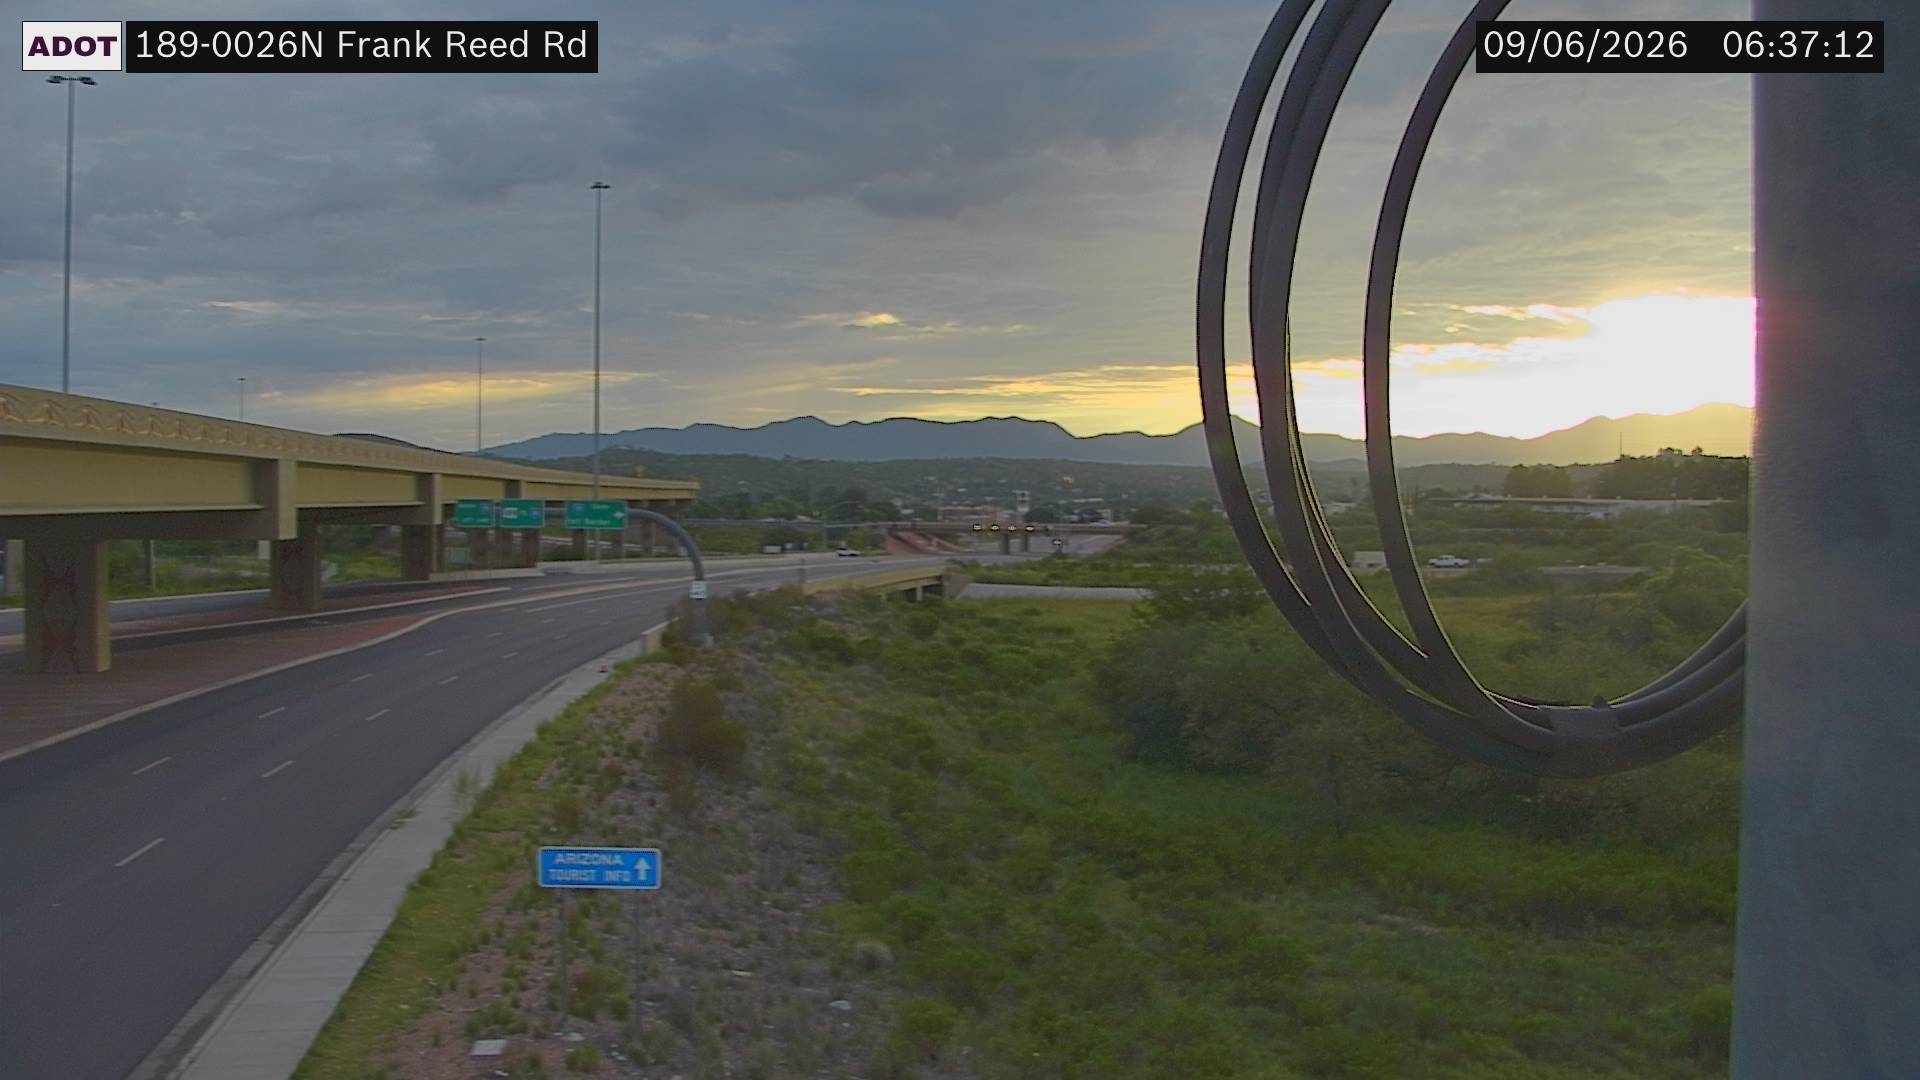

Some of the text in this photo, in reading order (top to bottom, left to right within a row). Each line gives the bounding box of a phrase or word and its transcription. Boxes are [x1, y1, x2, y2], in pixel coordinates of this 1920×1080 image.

[555, 853, 623, 866] ARIZONA
[549, 870, 630, 882] TOURIST INFO
